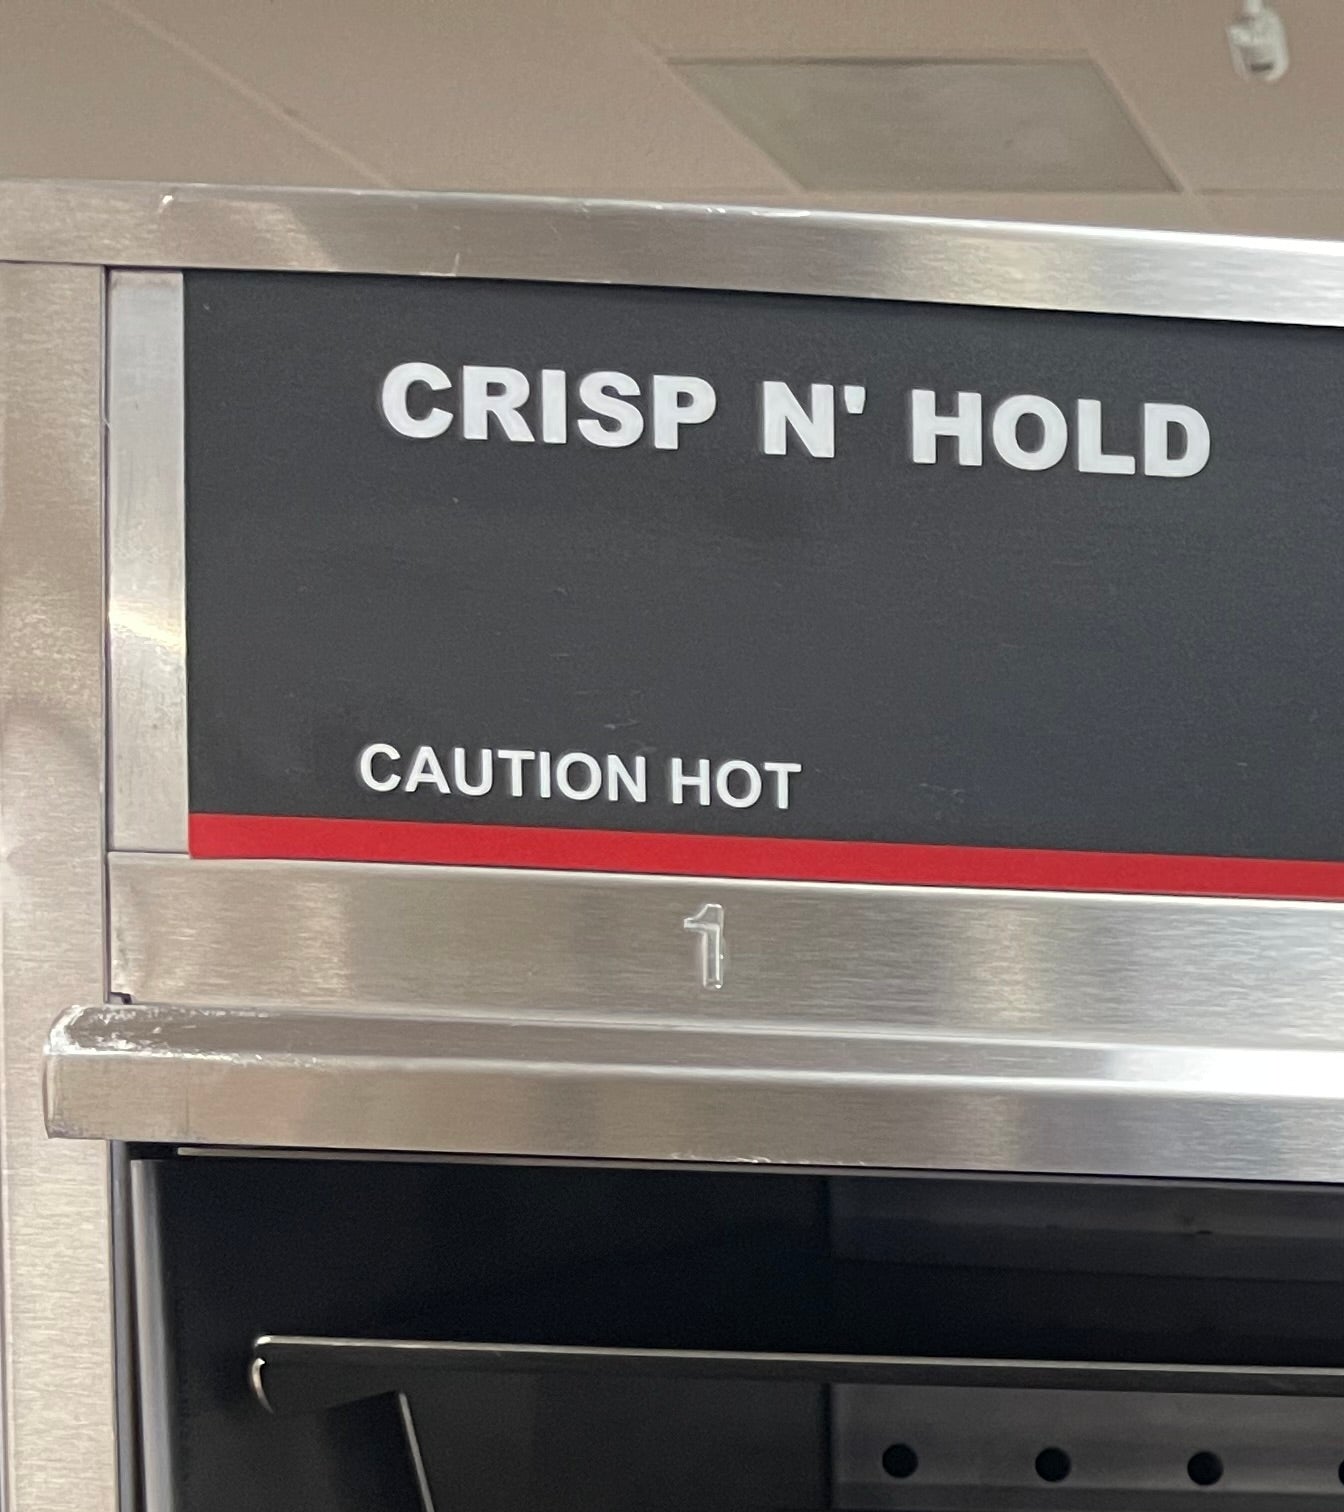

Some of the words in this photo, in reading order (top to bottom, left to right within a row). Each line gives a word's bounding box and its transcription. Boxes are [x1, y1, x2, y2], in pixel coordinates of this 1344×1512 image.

[380, 360, 718, 451] CRISP
[761, 379, 867, 460] N'
[909, 387, 1212, 479] HOLD
[358, 741, 648, 804] CAUTION
[668, 757, 803, 811] HOT
[683, 903, 725, 990] 1
